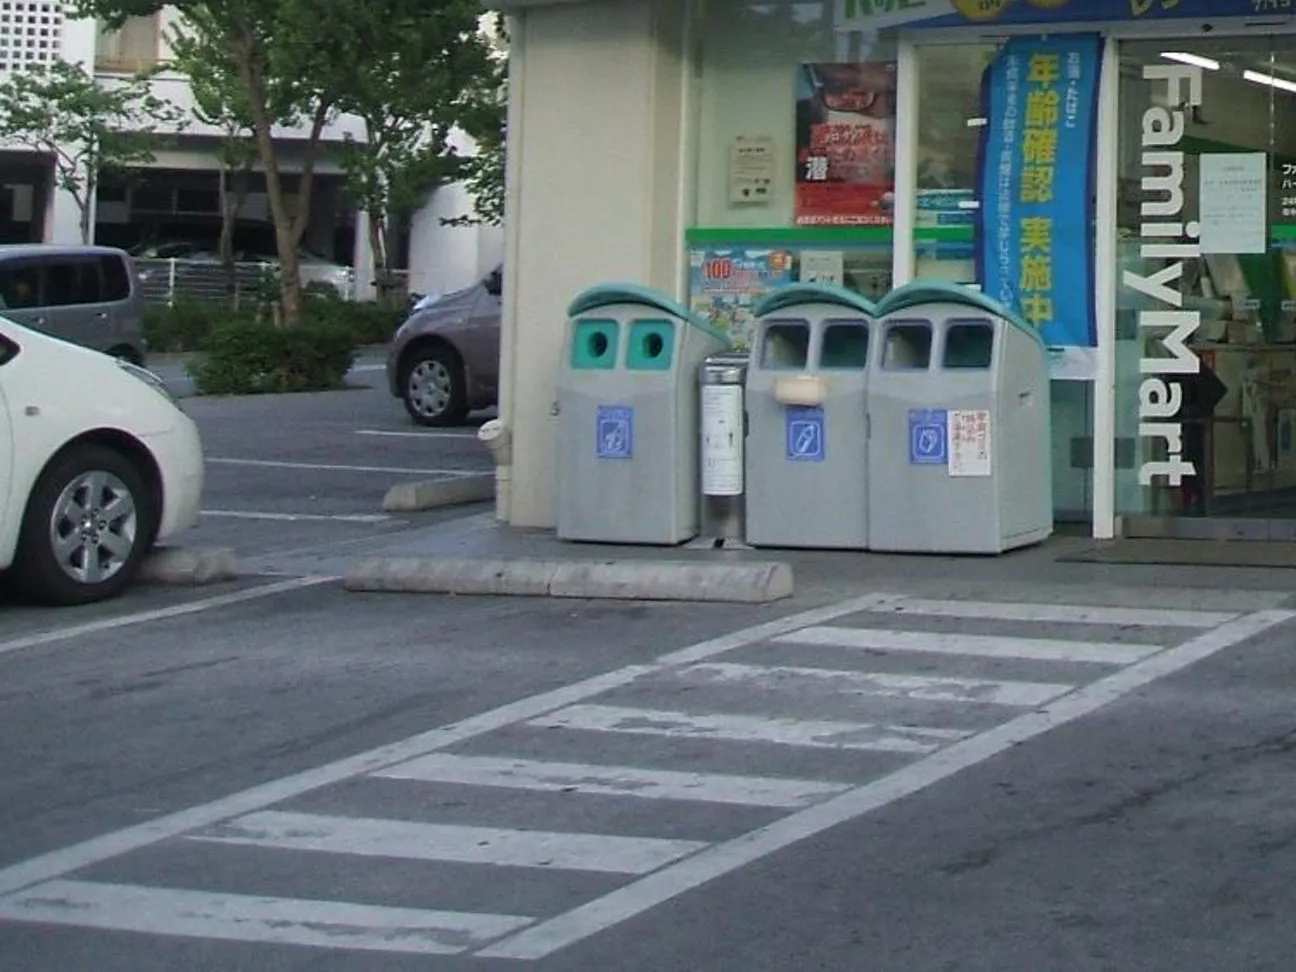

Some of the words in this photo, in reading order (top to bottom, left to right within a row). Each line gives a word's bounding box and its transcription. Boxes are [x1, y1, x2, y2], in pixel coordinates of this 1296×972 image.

[1020, 53, 1061, 203] 年齢確認
[1019, 217, 1053, 327] 実施中
[1123, 64, 1200, 486] FamilyMart
